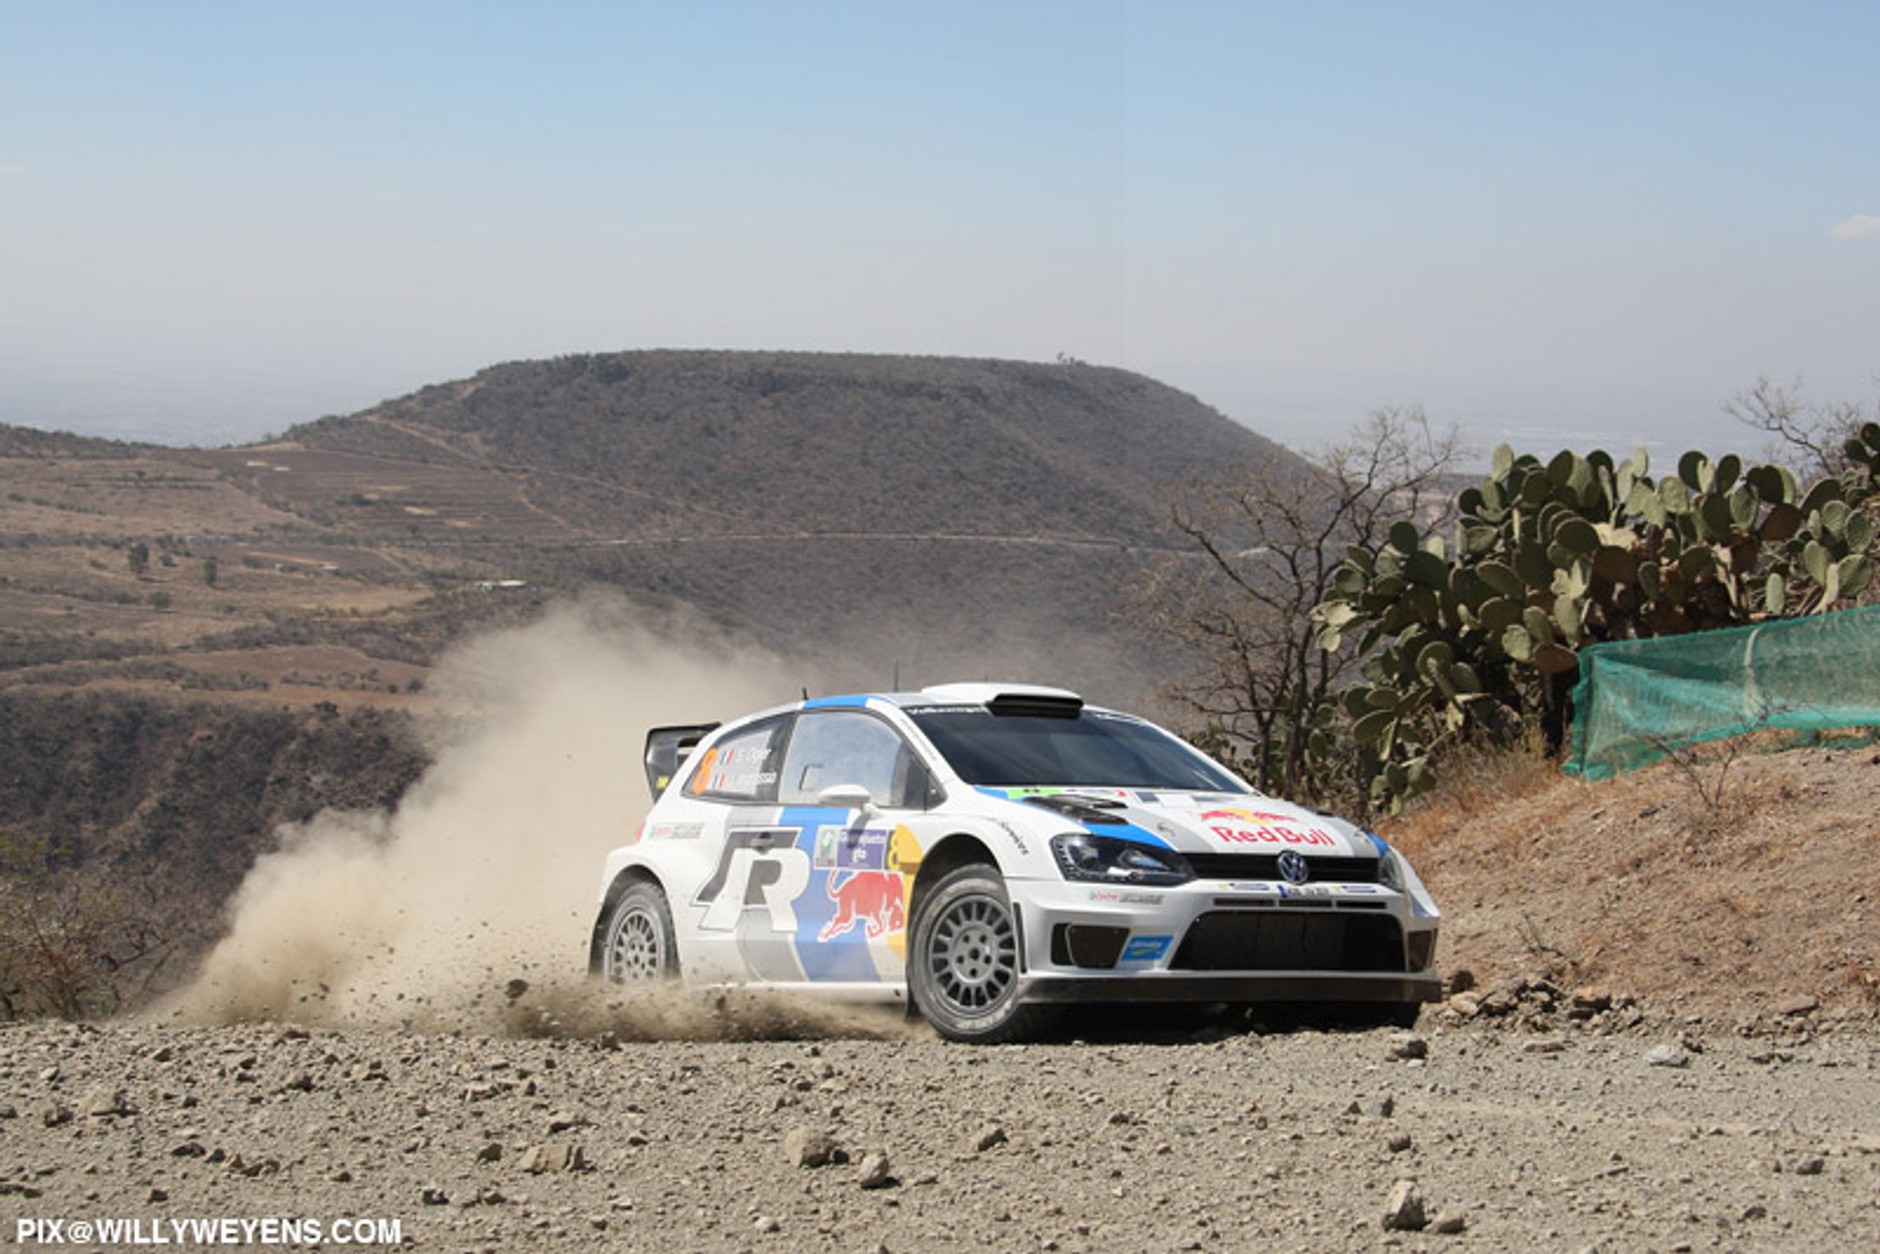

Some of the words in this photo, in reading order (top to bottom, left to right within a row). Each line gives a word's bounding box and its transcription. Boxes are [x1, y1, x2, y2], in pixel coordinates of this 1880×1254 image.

[692, 747, 718, 795] 8
[1210, 826, 1279, 842] Red
[1272, 826, 1336, 846] Bull
